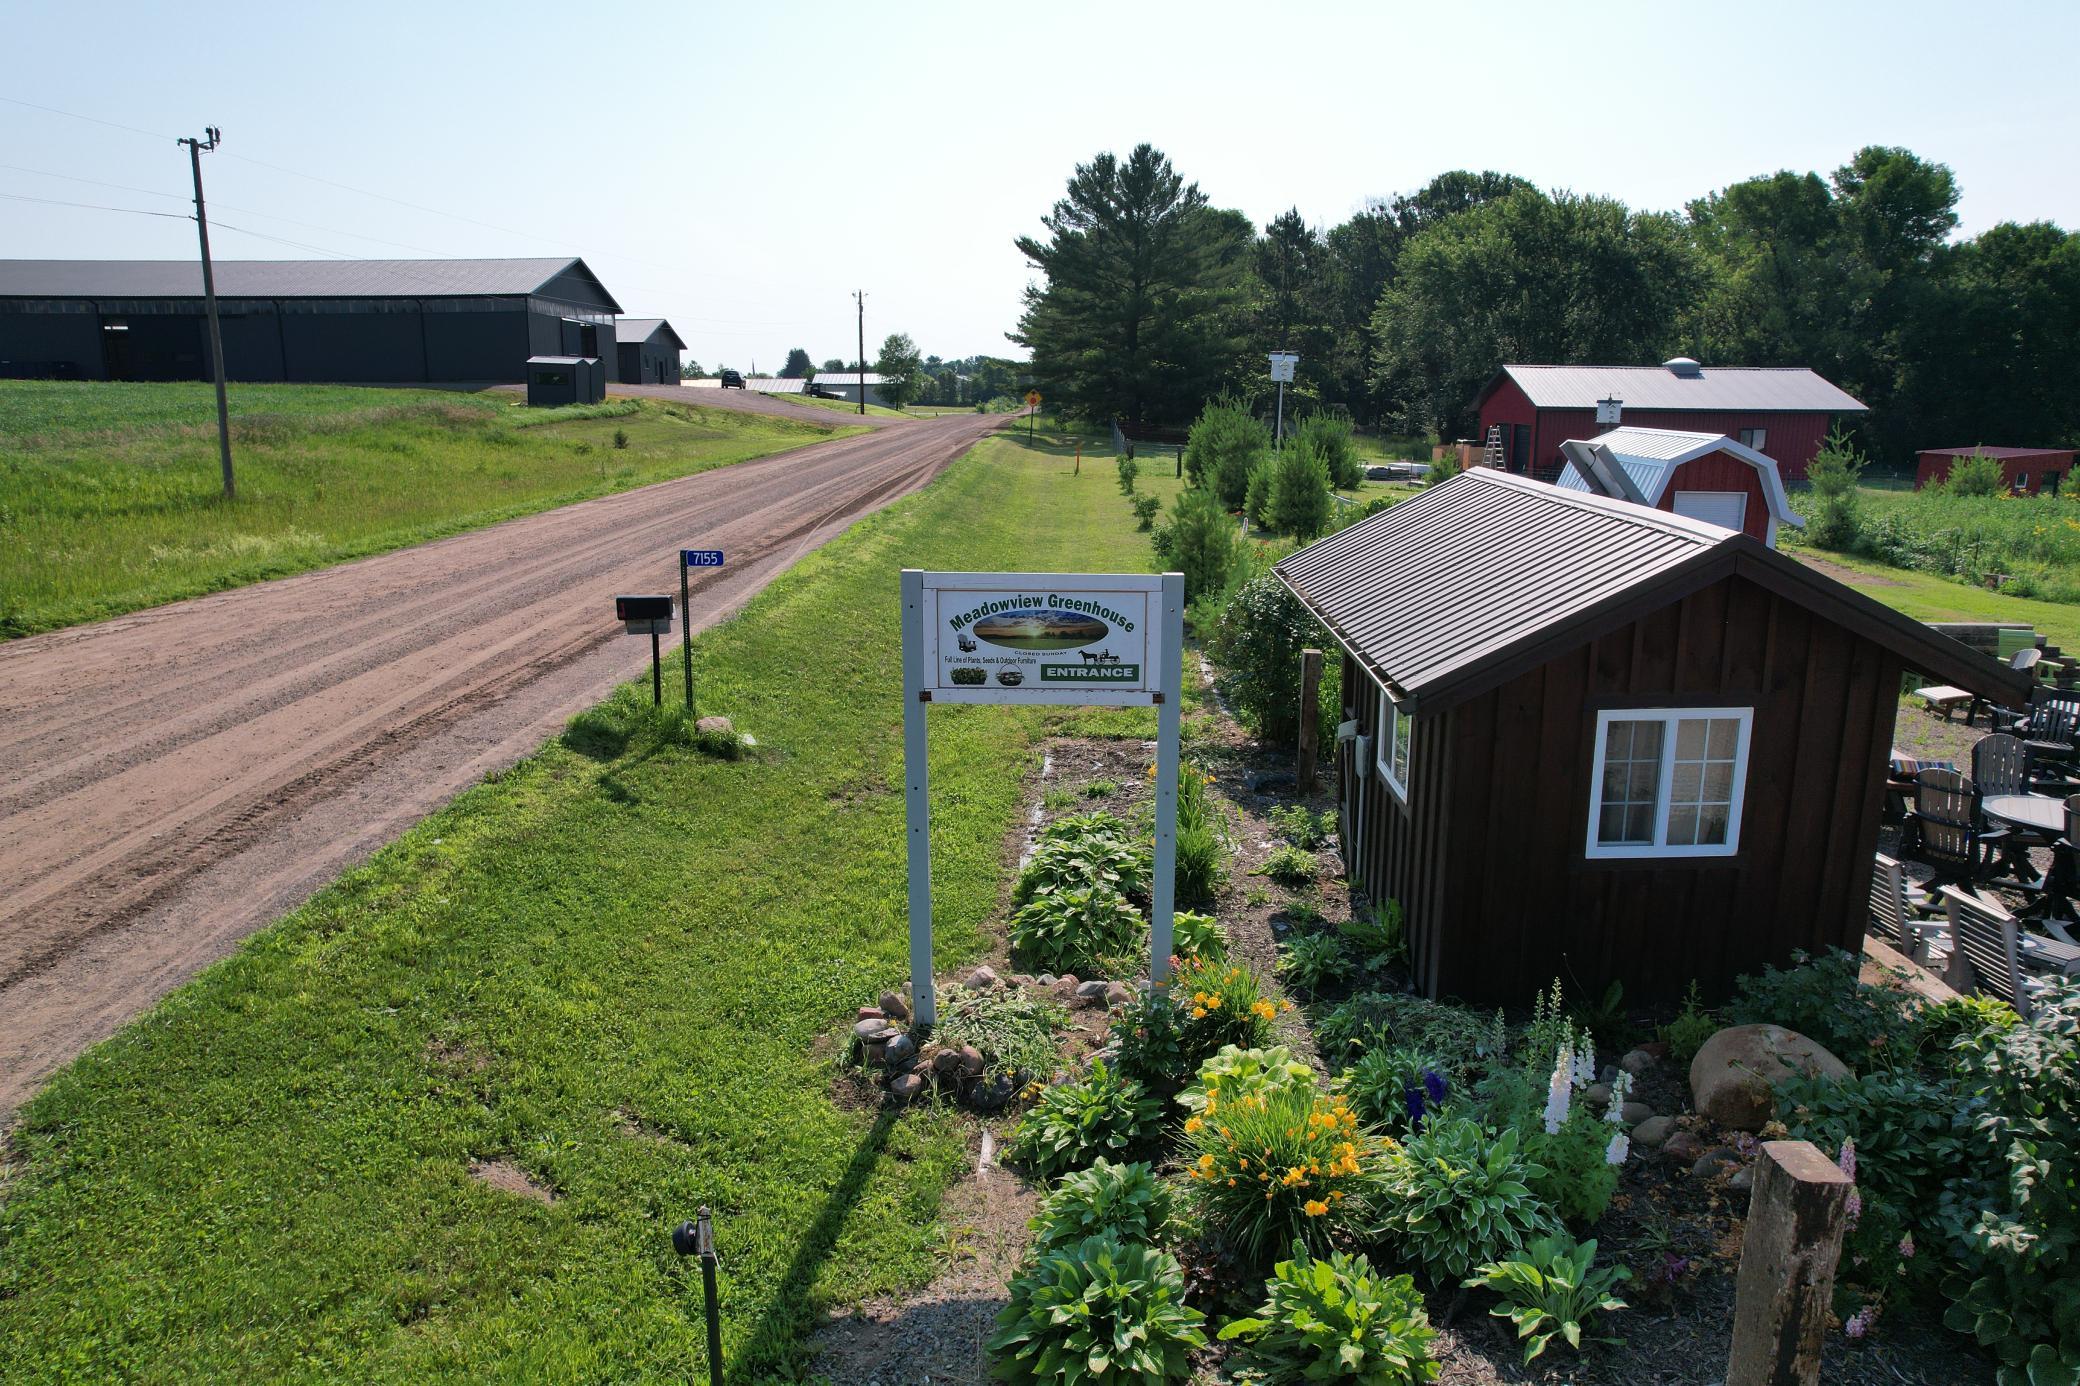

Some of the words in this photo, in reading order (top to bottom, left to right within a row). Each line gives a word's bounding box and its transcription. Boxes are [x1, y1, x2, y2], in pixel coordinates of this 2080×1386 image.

[693, 552, 718, 565] 7155
[949, 594, 1043, 632] Meadowview
[1047, 593, 1135, 633] Greenhouse
[982, 656, 996, 664] Seeds
[1000, 656, 1018, 665] Outdoor
[1017, 656, 1037, 665] Furniture
[1046, 667, 1133, 678] ENTRANCE
